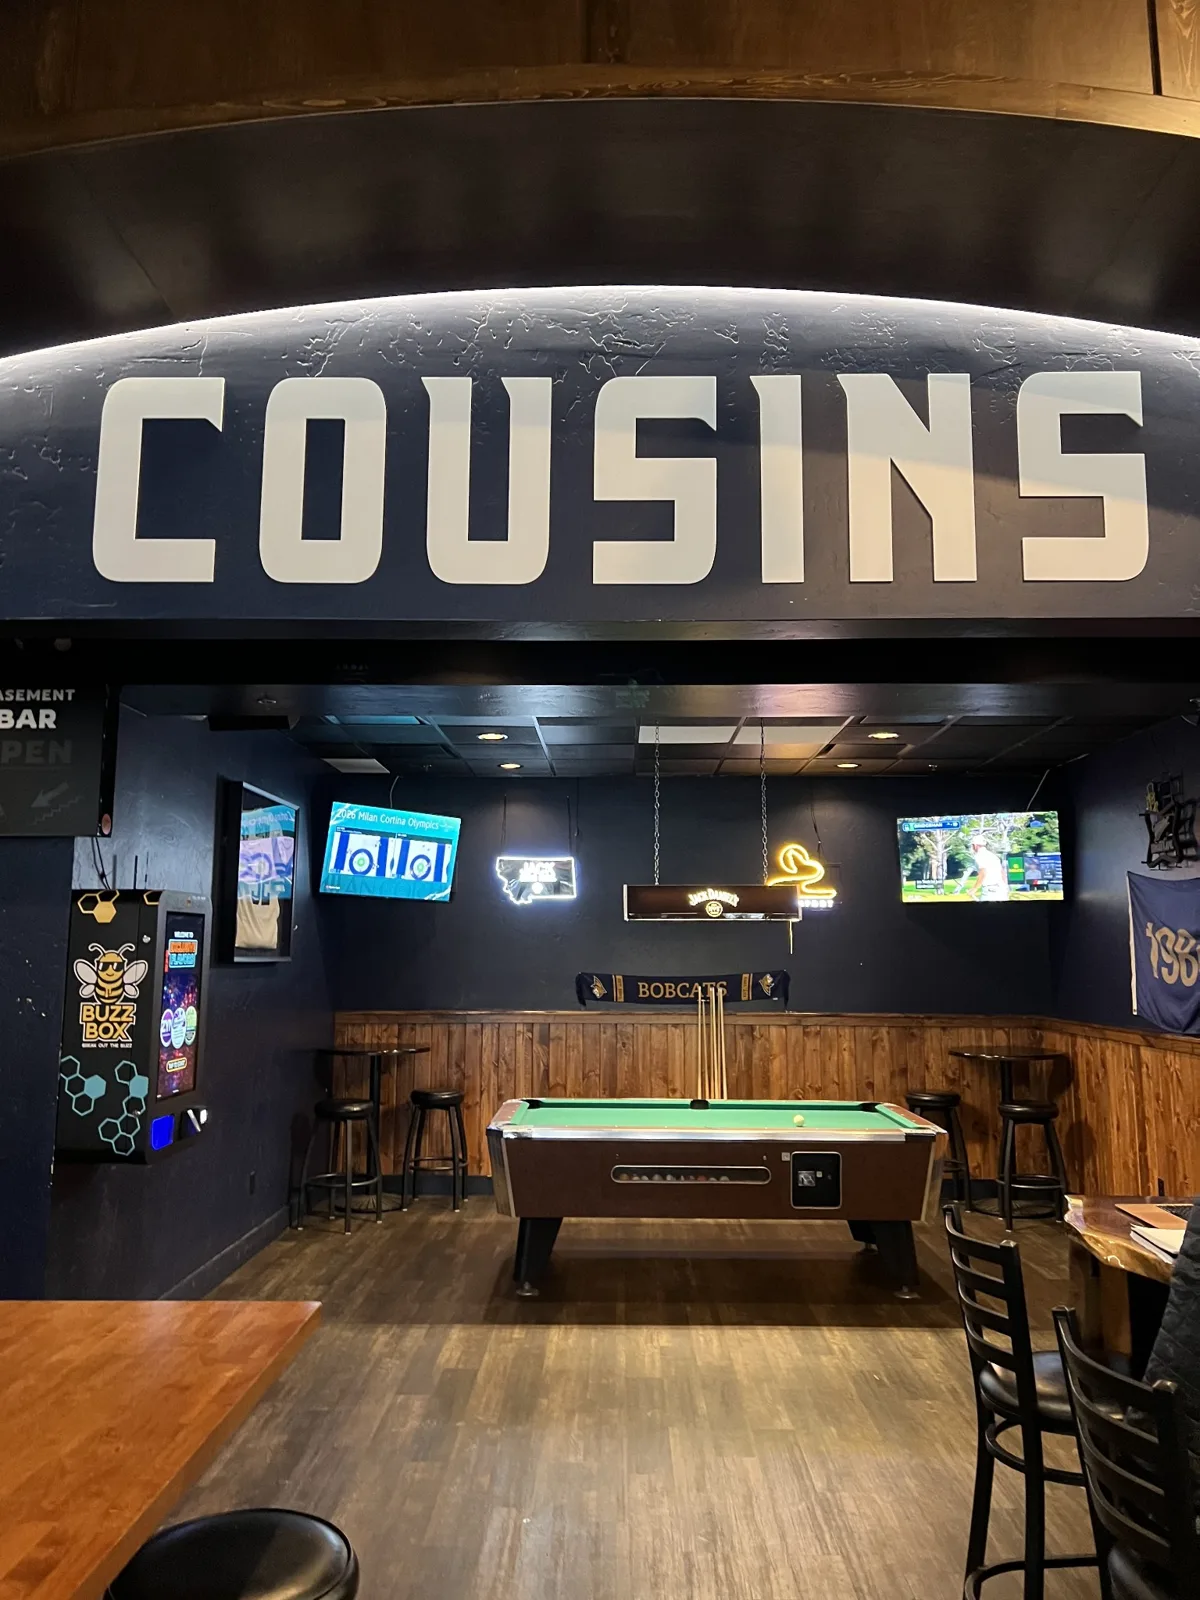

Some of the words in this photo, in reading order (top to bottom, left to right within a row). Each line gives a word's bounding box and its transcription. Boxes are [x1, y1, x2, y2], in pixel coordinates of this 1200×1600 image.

[92, 370, 1150, 586] COUSINS
[0, 708, 57, 729] BAR
[358, 811, 377, 822] Milan
[380, 814, 405, 825] Cortina
[407, 817, 439, 830] Olympics
[1146, 922, 1200, 987] 198
[637, 981, 728, 998] BOBCATS
[82, 1004, 134, 1022] BUZZ
[85, 1022, 128, 1039] BOX
